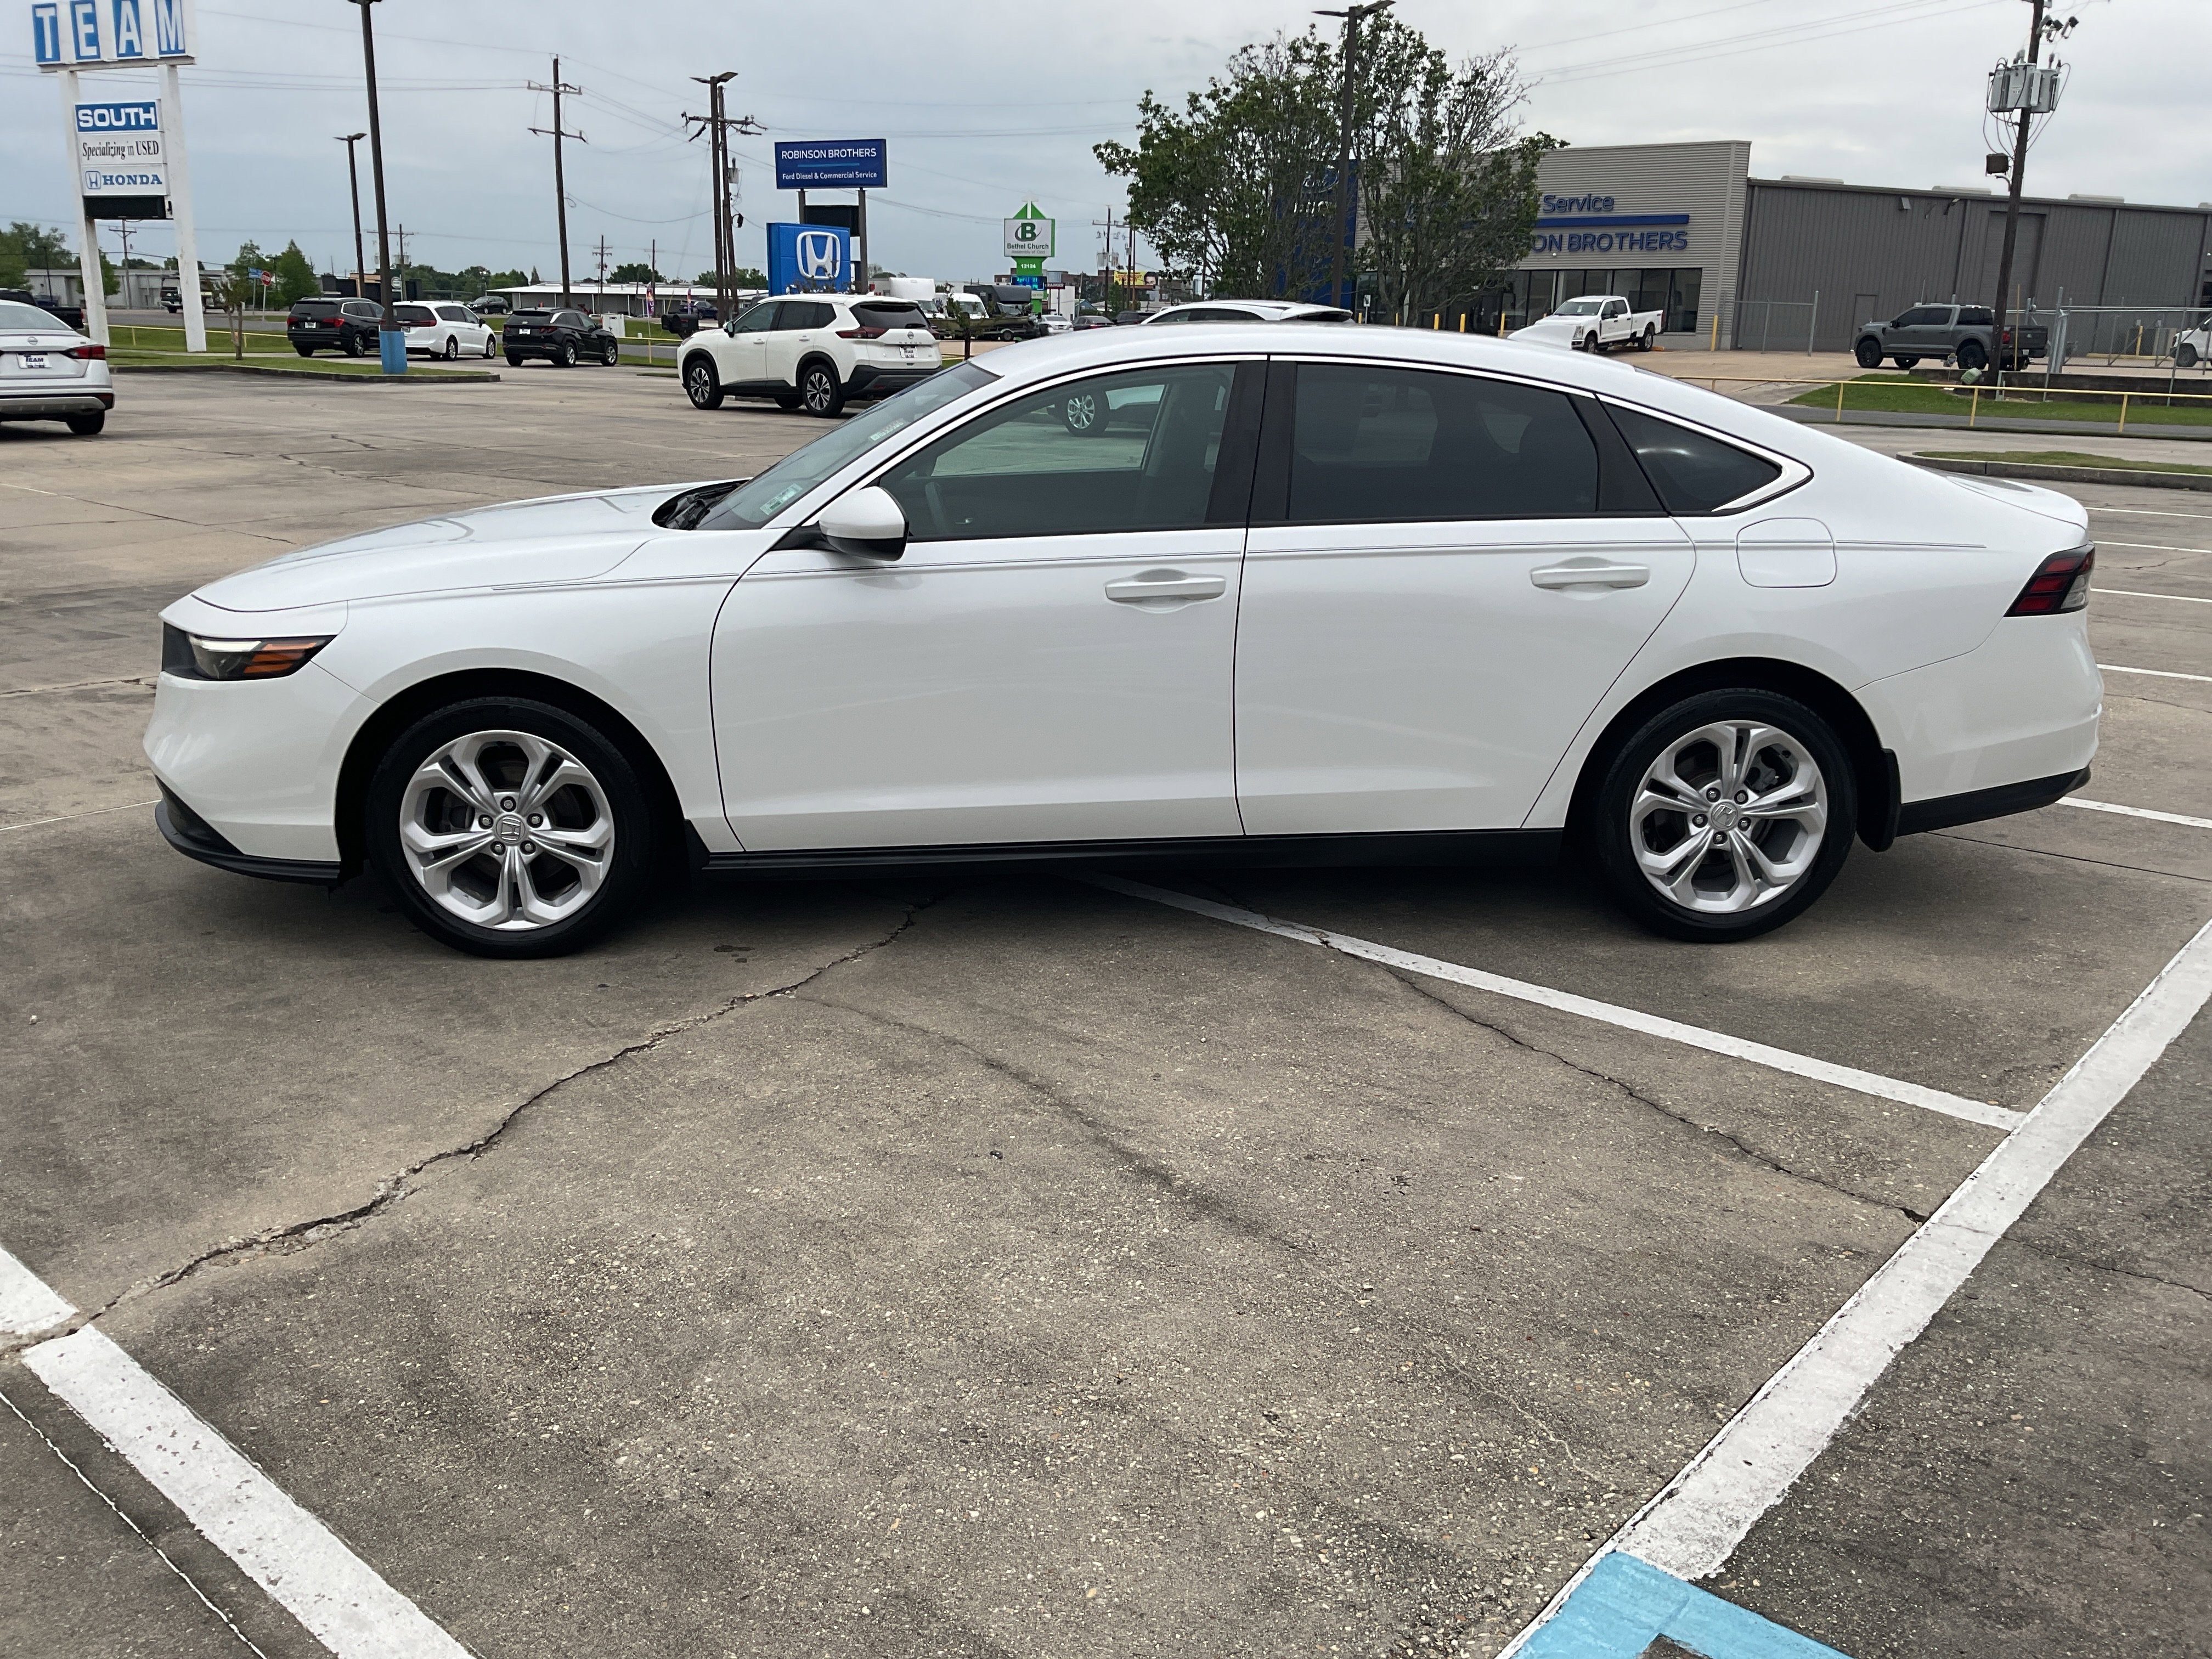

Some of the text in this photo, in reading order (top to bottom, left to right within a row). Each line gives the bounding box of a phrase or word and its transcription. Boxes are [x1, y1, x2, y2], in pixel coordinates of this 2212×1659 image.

[35, 0, 184, 59] TEAM
[78, 107, 156, 127] SOUTH
[82, 140, 159, 160] Specializing in USED
[781, 148, 877, 159] ROBINSON BROTHERS
[102, 174, 162, 185] HONDA
[1542, 194, 1615, 213] Service
[1567, 230, 1688, 252] BROTHERS
[24, 354, 44, 362] TEAM
